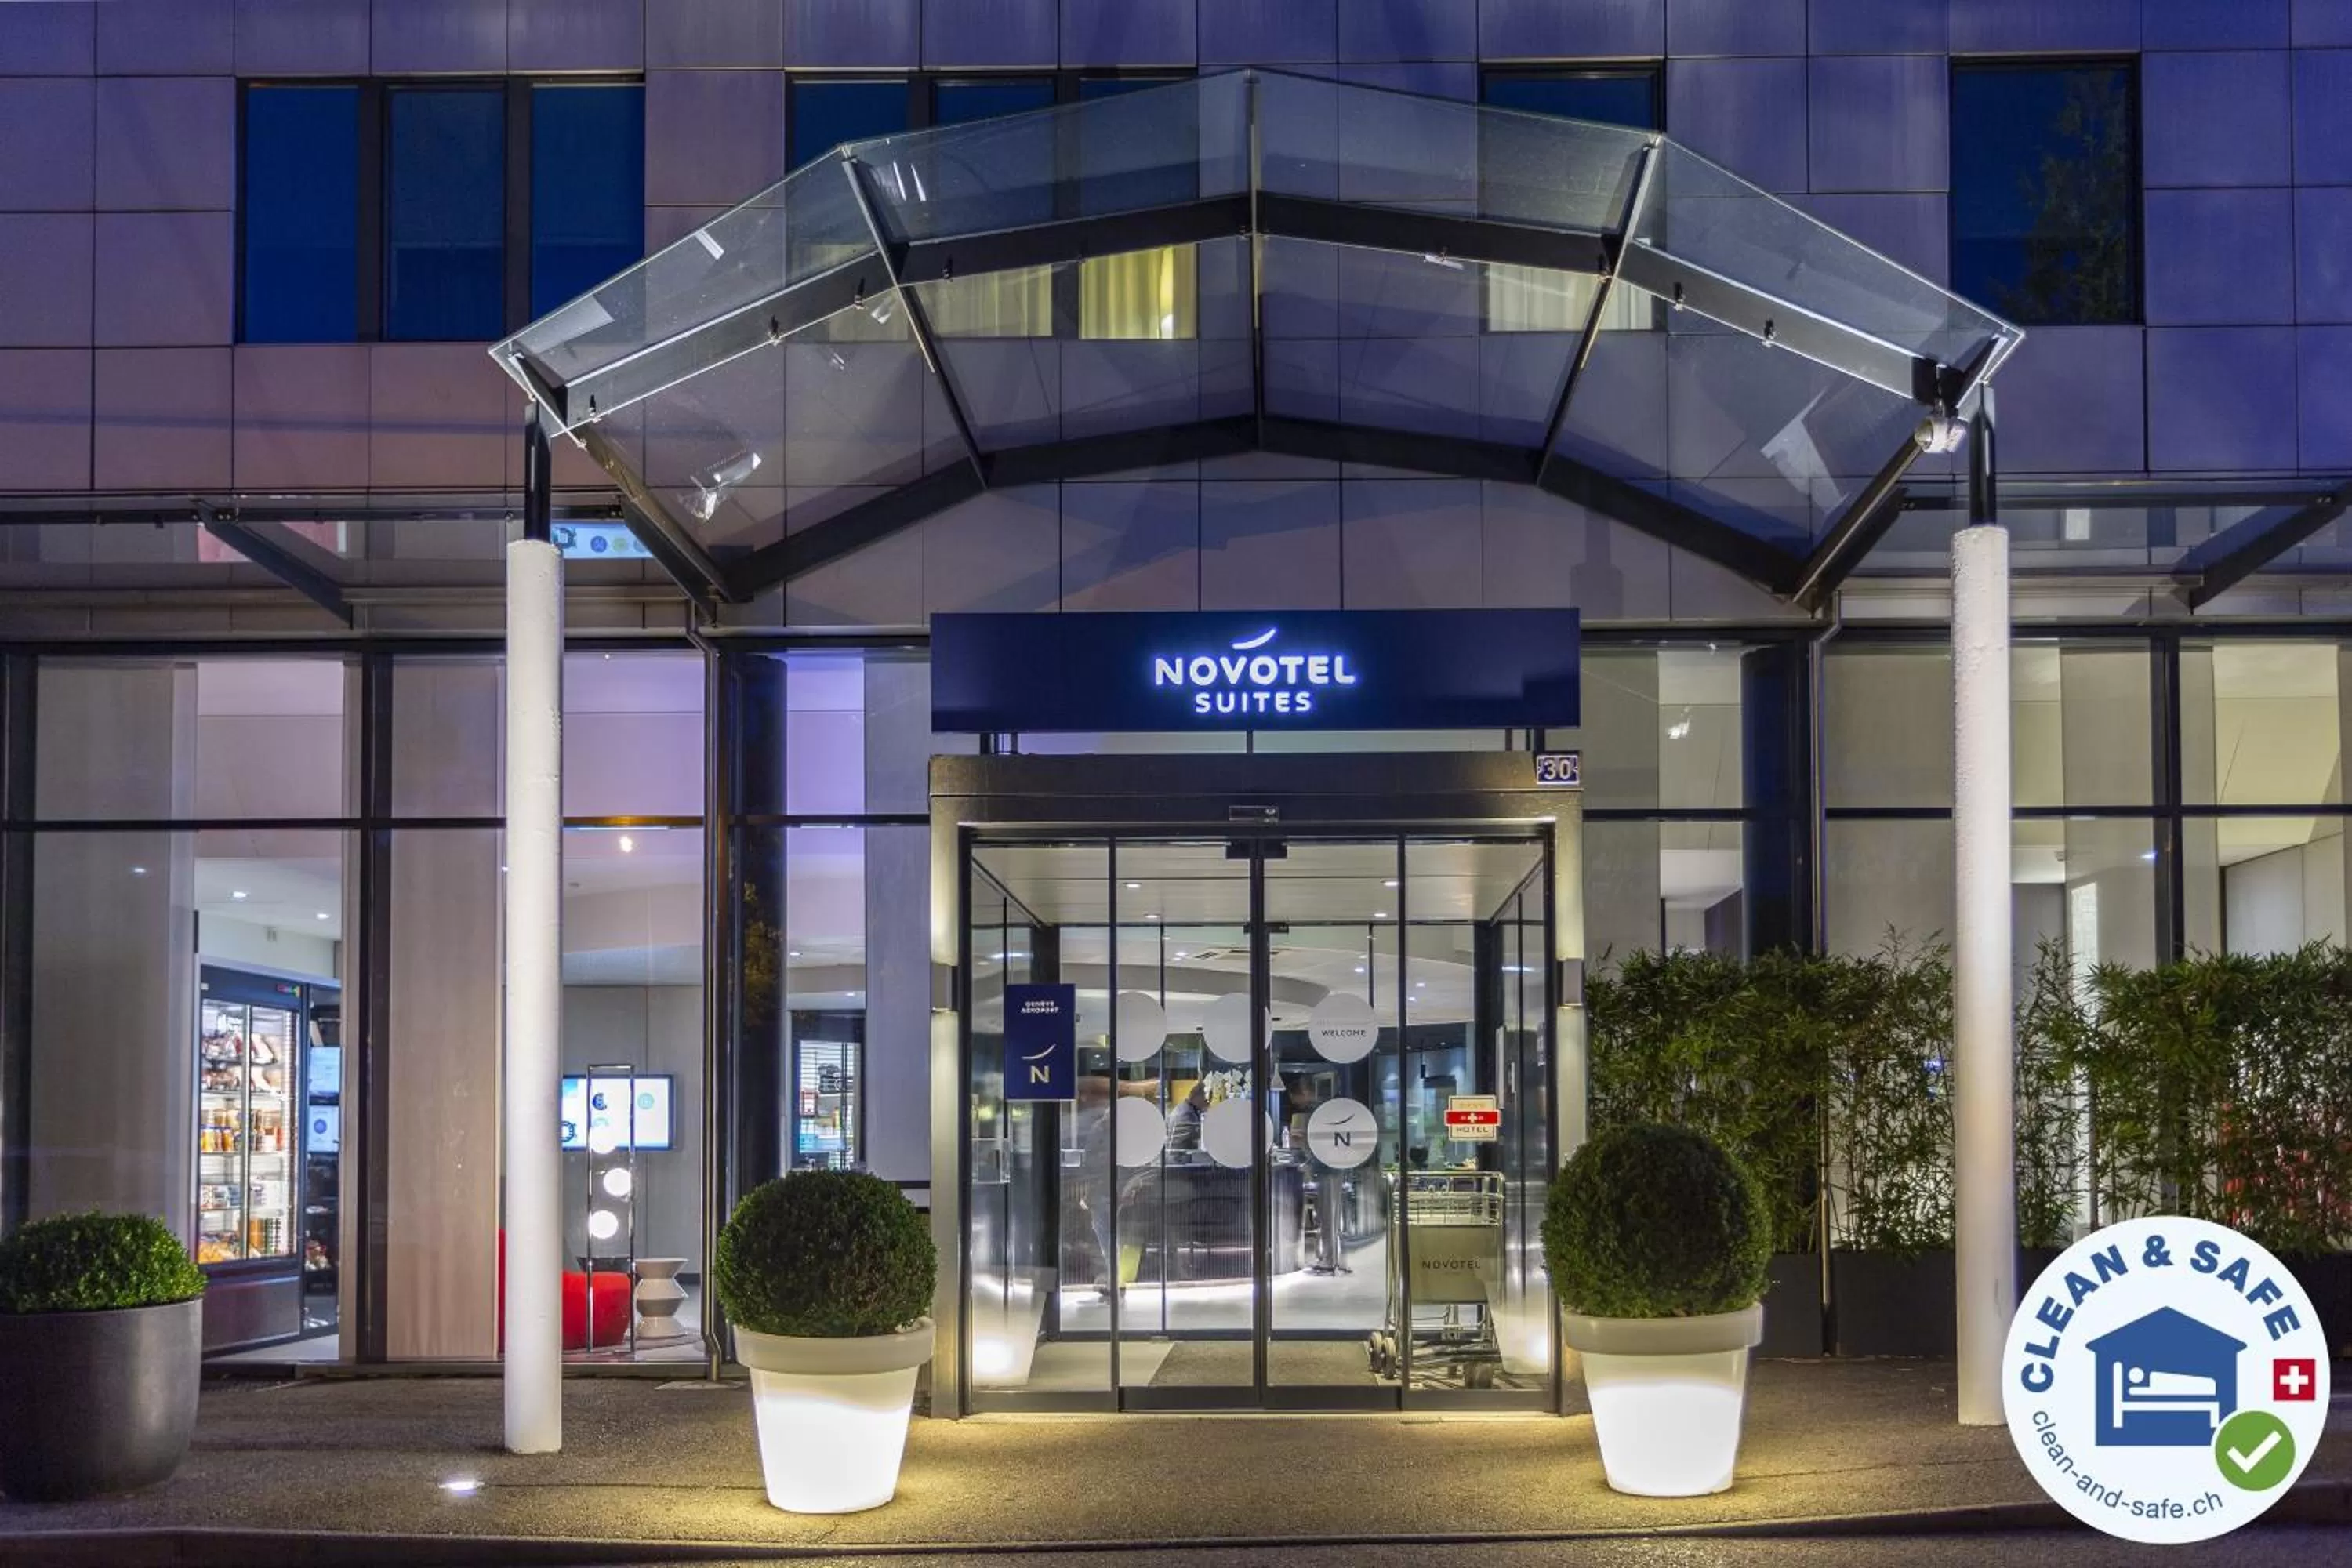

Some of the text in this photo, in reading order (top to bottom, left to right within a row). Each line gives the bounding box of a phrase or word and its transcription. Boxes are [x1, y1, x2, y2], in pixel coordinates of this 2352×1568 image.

[1155, 655, 1356, 685] NOVOTEL
[1196, 691, 1312, 713] SUITES
[1544, 760, 1571, 779] 30
[1030, 1065, 1050, 1083] N
[1334, 1131, 1351, 1146] N
[1421, 1260, 1481, 1269] NOVOTEL
